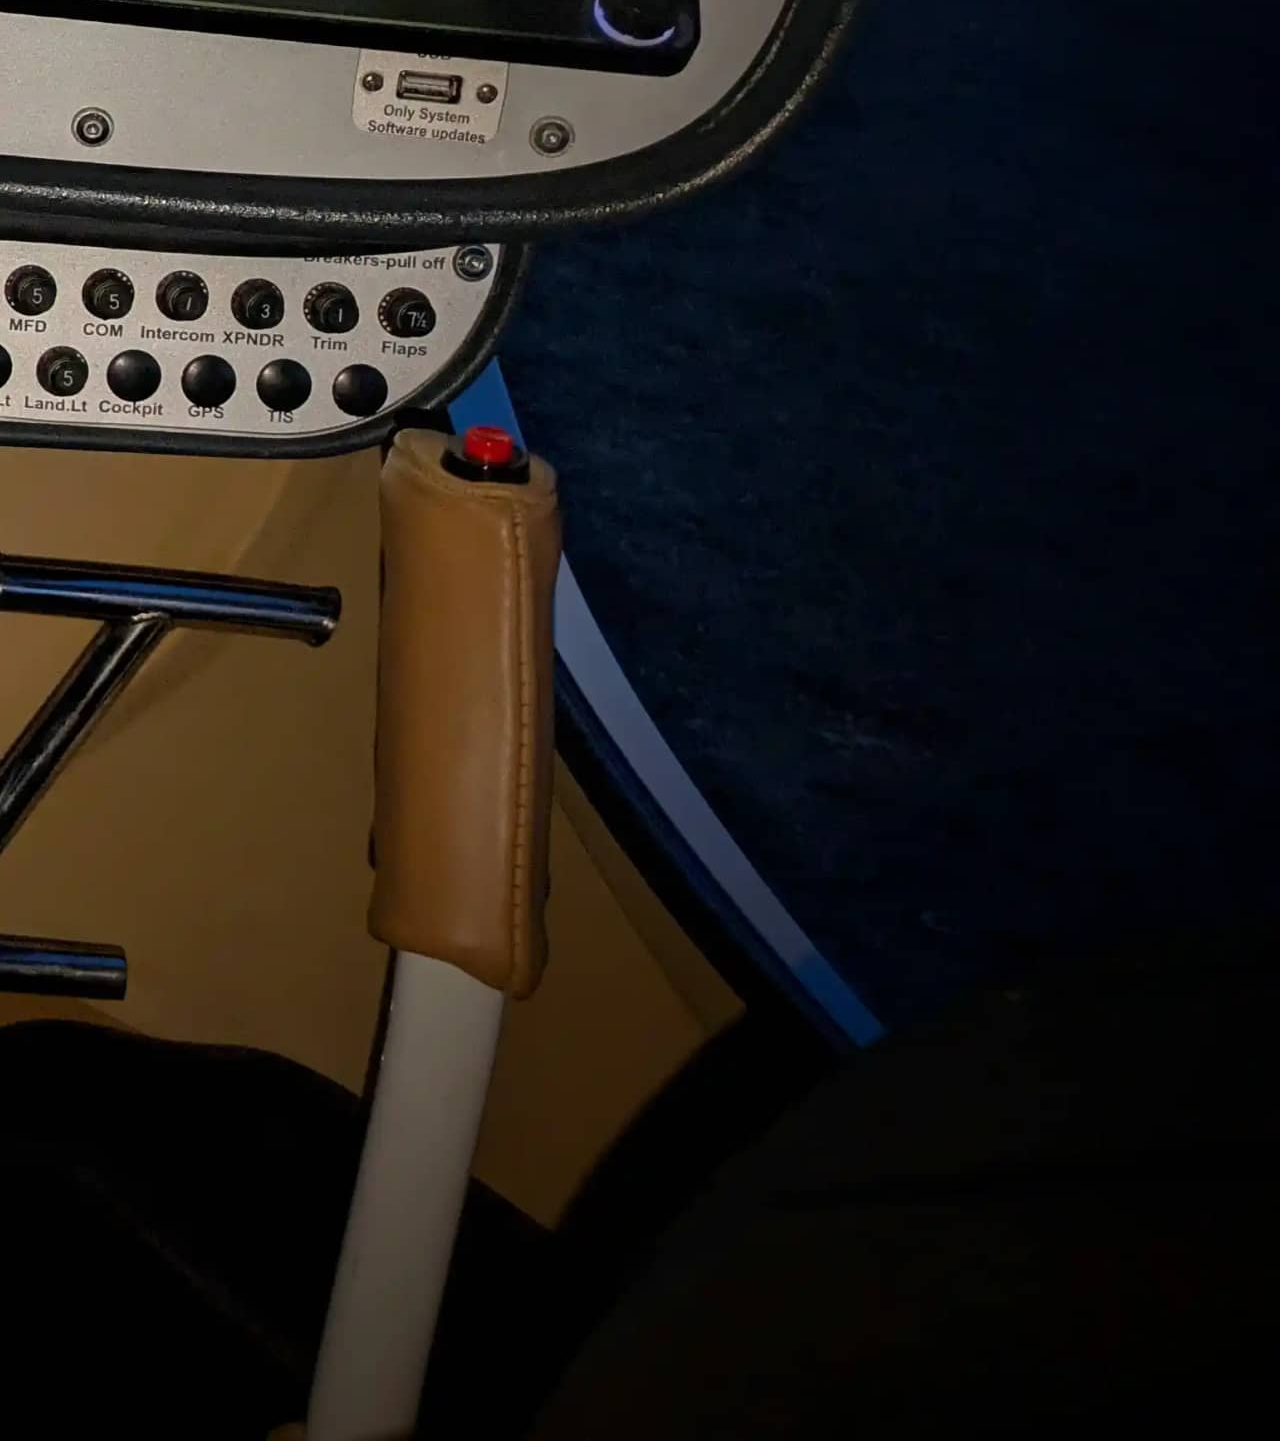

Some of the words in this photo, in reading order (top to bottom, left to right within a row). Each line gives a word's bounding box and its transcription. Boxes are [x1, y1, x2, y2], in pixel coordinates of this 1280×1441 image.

[9, 319, 46, 333] MFD
[83, 323, 122, 337] COM
[140, 326, 215, 342] Intercom
[222, 331, 284, 347] XPNDR
[311, 336, 347, 350] Trim
[381, 341, 427, 357] Flaps
[24, 395, 88, 413] Land.Lt
[99, 400, 163, 417] Cockpit
